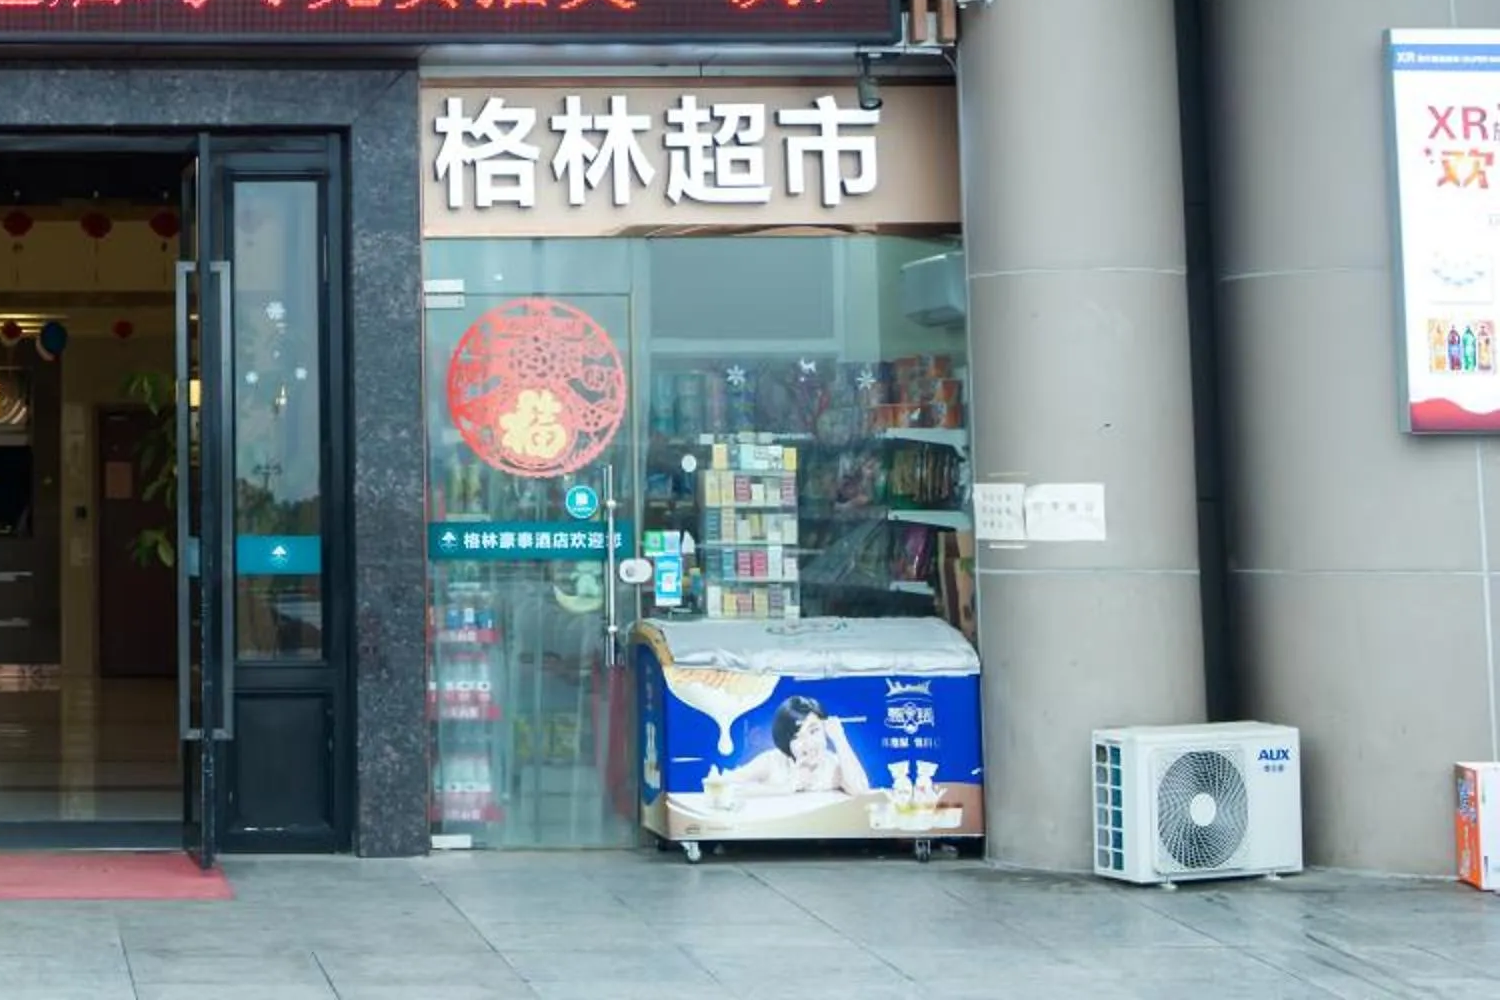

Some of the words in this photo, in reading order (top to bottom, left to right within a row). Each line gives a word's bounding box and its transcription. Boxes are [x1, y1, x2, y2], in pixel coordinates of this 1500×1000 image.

[1427, 105, 1489, 141] XR
[434, 95, 881, 207] 格林超市
[1257, 749, 1291, 761] AUX
